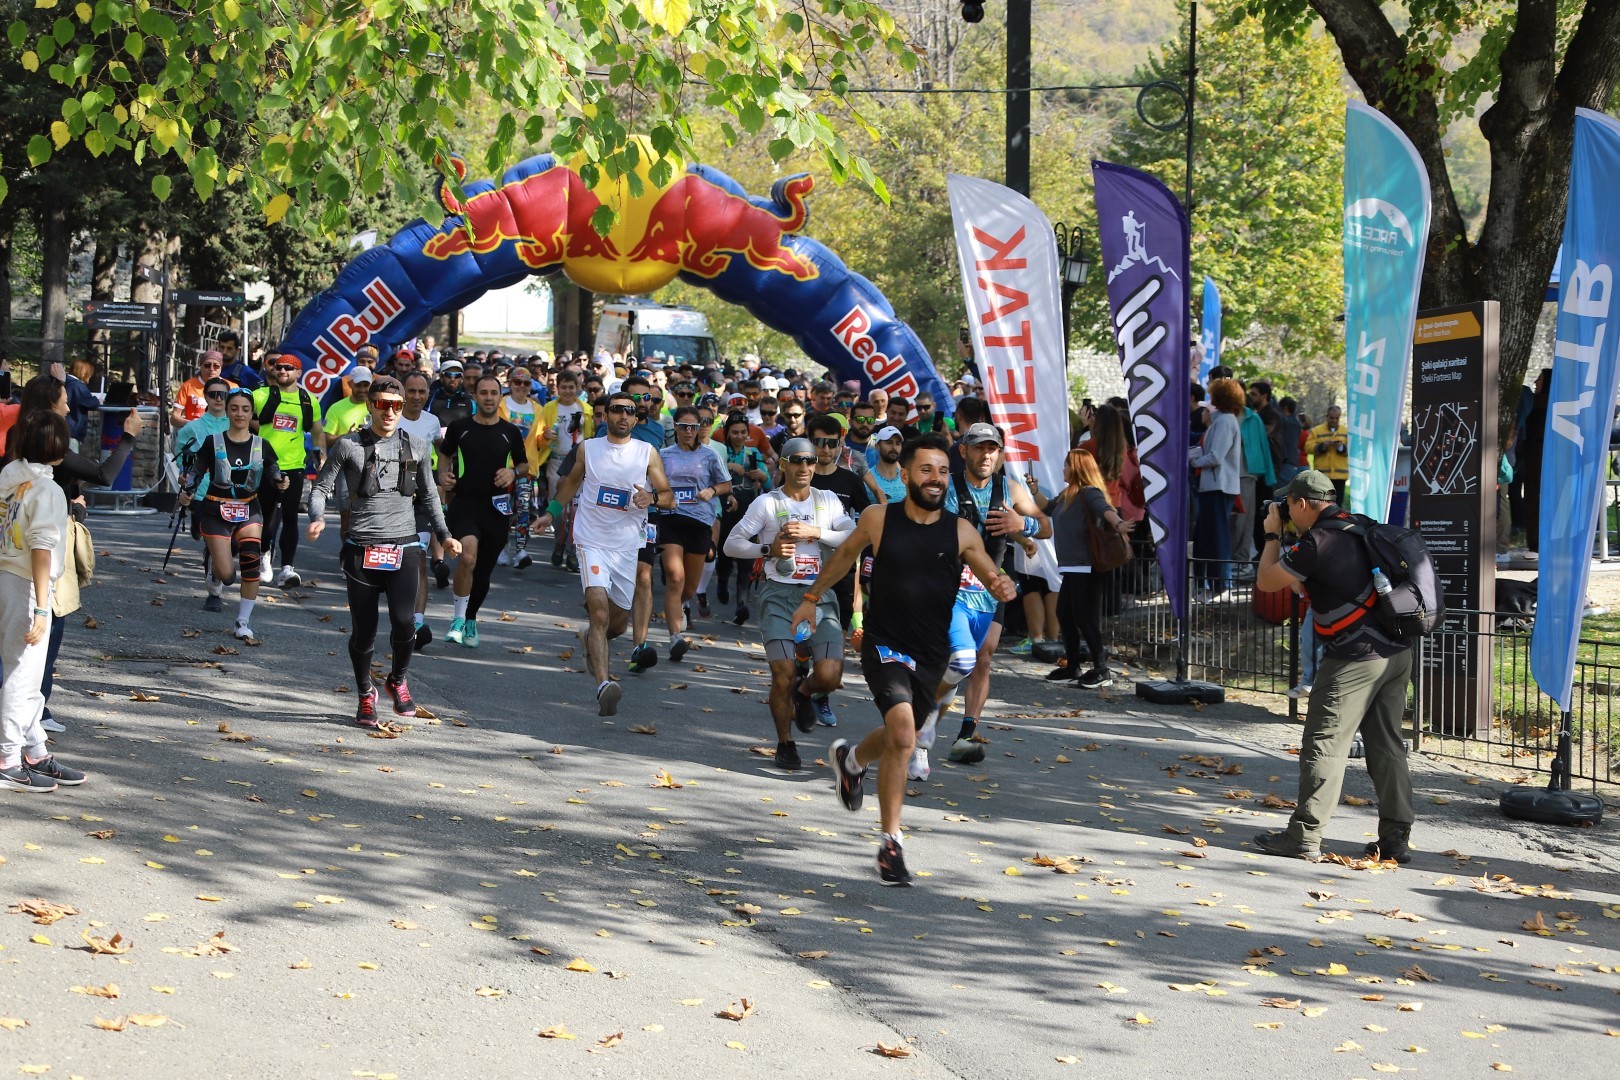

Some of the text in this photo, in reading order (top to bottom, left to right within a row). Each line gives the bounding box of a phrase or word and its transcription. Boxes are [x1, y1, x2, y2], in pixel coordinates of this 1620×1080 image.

[302, 277, 404, 400] ed Bull
[832, 305, 905, 384] Red
[1433, 373, 1452, 382] Fortress
[1451, 371, 1463, 382] Map
[275, 418, 295, 428] 277
[1394, 478, 1407, 488] ull
[602, 492, 620, 505] 65
[674, 490, 692, 500] 104
[223, 507, 246, 518] 246
[368, 551, 398, 565] 285
